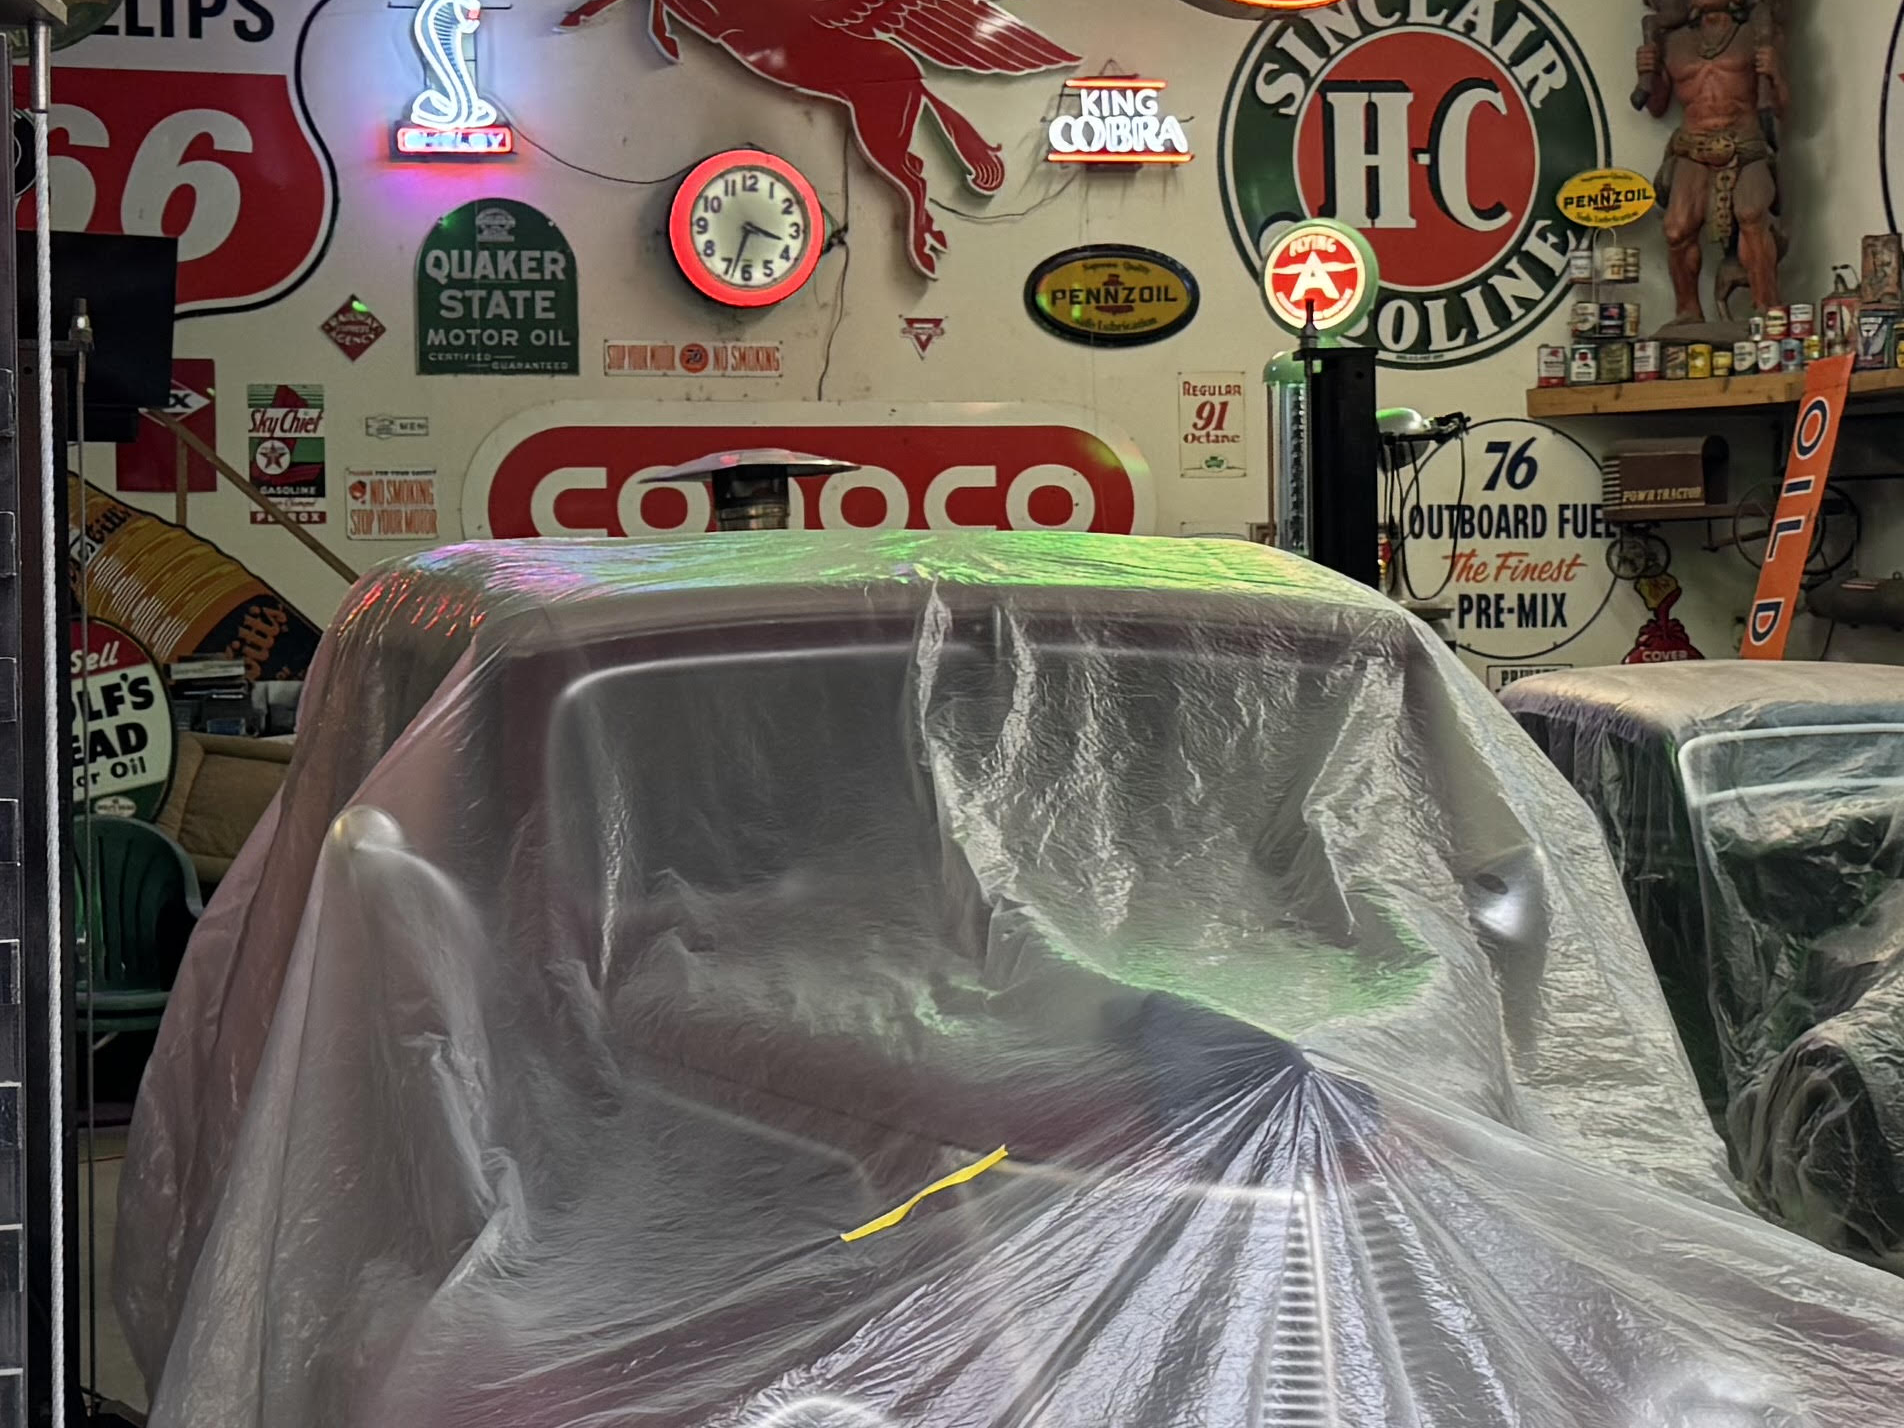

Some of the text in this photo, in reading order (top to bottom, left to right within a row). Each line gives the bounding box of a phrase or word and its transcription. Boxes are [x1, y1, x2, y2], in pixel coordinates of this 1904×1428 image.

[1080, 88, 1158, 117] KING
[1048, 115, 1187, 154] COBRA
[1326, 87, 1513, 231] H-C
[724, 176, 737, 195] 11
[741, 173, 759, 192] 12
[767, 182, 775, 199] 1
[702, 196, 721, 213] 10
[781, 198, 794, 214] 2
[1564, 188, 1652, 209] PENNZOIL
[696, 218, 708, 234] 9
[788, 222, 800, 239] 3
[703, 240, 714, 256] 8
[778, 244, 792, 263] 4
[1289, 235, 1336, 257] FLYING
[425, 249, 565, 284] QUAKER
[722, 257, 732, 274] 7
[741, 264, 753, 281] 6
[762, 260, 774, 277] 5
[1290, 251, 1339, 302] A
[439, 290, 555, 319] STATE
[1051, 282, 1177, 307] PENNZOIL
[426, 329, 571, 347] MOTOR OIL
[429, 352, 491, 361] CERTIFIED
[492, 360, 568, 370] GUARANTEED
[713, 345, 780, 371] NO SMOKING
[1183, 381, 1241, 396] REGULAR
[248, 409, 322, 437] Sky Chief
[1193, 401, 1229, 431] 91
[1183, 431, 1240, 443] Octane
[1483, 437, 1537, 490] 76
[260, 486, 316, 495] GASOLINE
[370, 479, 433, 505] NO SMOKING
[531, 462, 1096, 534] COOCO
[350, 510, 437, 535] STOP YOUR MOTOR
[1409, 504, 1546, 539] OUTBOARD
[1442, 548, 1588, 583] The Finest
[1458, 593, 1567, 629] PRE-MIX
[71, 641, 119, 673] Sell
[1642, 649, 1688, 661] COVER
[111, 756, 146, 778] Oil
